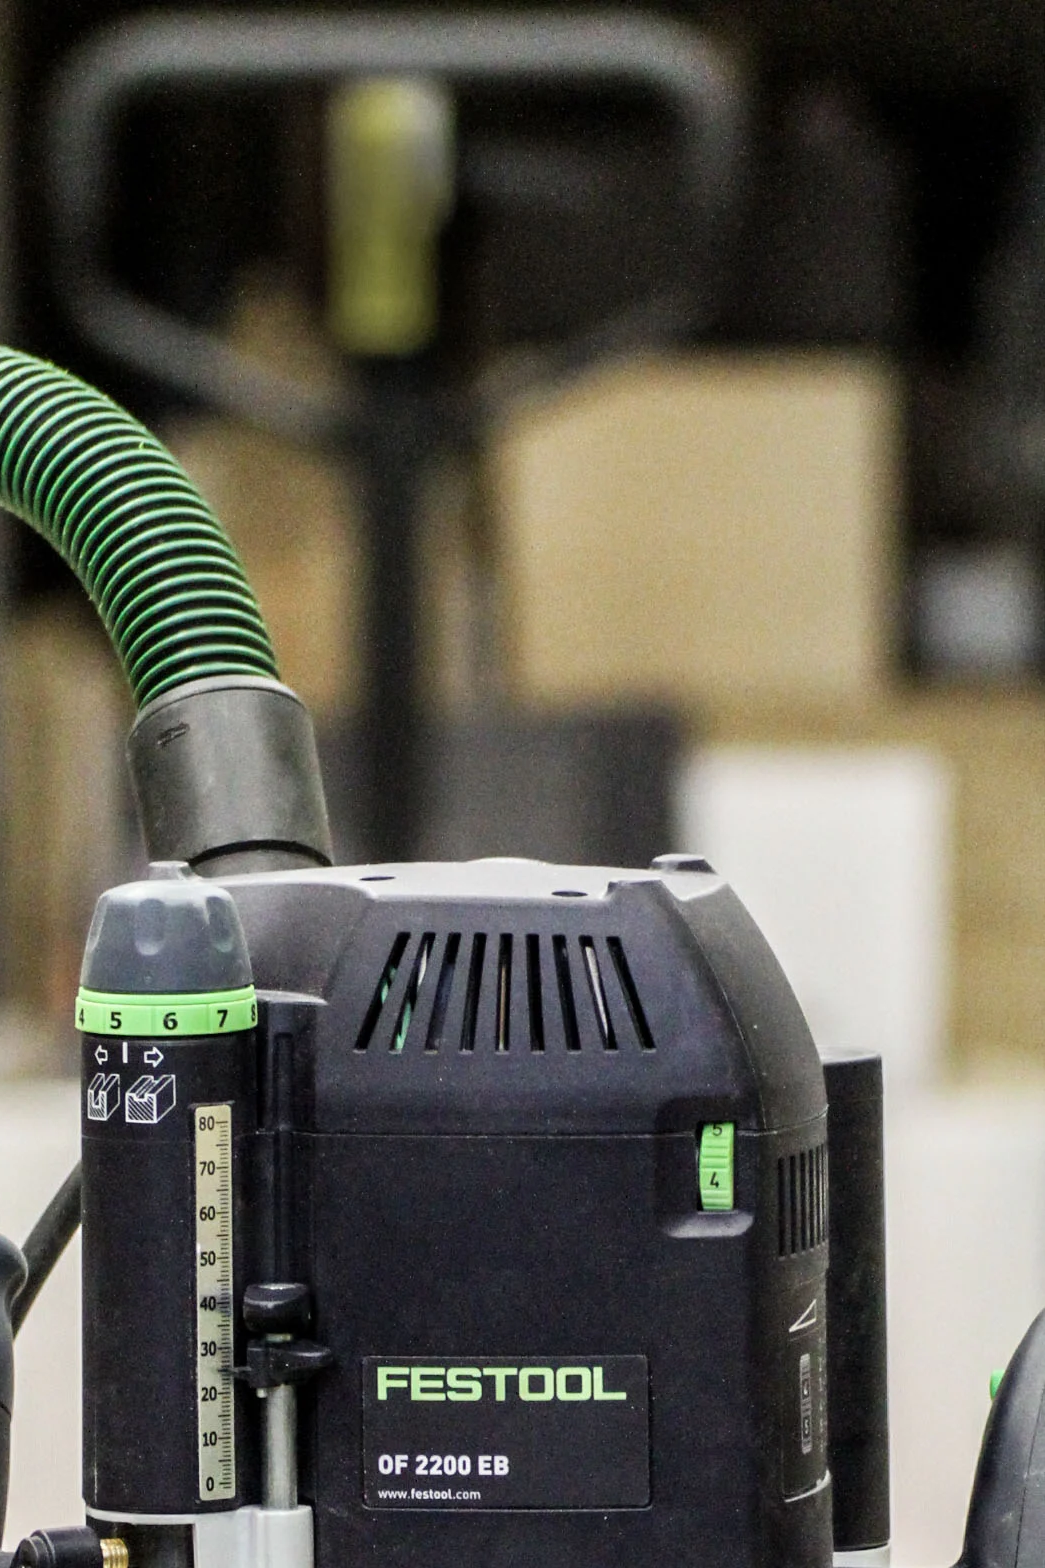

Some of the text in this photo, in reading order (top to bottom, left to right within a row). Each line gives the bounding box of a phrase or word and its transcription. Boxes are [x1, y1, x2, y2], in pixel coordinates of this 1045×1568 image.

[110, 1011, 122, 1030] 5
[163, 1012, 178, 1030] 6
[217, 1009, 229, 1028] 7
[198, 1116, 215, 1131] 80
[199, 1161, 216, 1176] 70
[710, 1171, 720, 1188] 4
[199, 1206, 216, 1221] 60
[199, 1251, 216, 1266] 50
[199, 1295, 216, 1311] 40
[200, 1341, 217, 1356] 30
[376, 1366, 627, 1402] FESTOOL
[201, 1386, 217, 1401] 20
[202, 1431, 217, 1446] 10
[378, 1454, 510, 1476] OF 2200 EB
[206, 1476, 215, 1492] 0
[377, 1487, 482, 1501] www.festool.com
